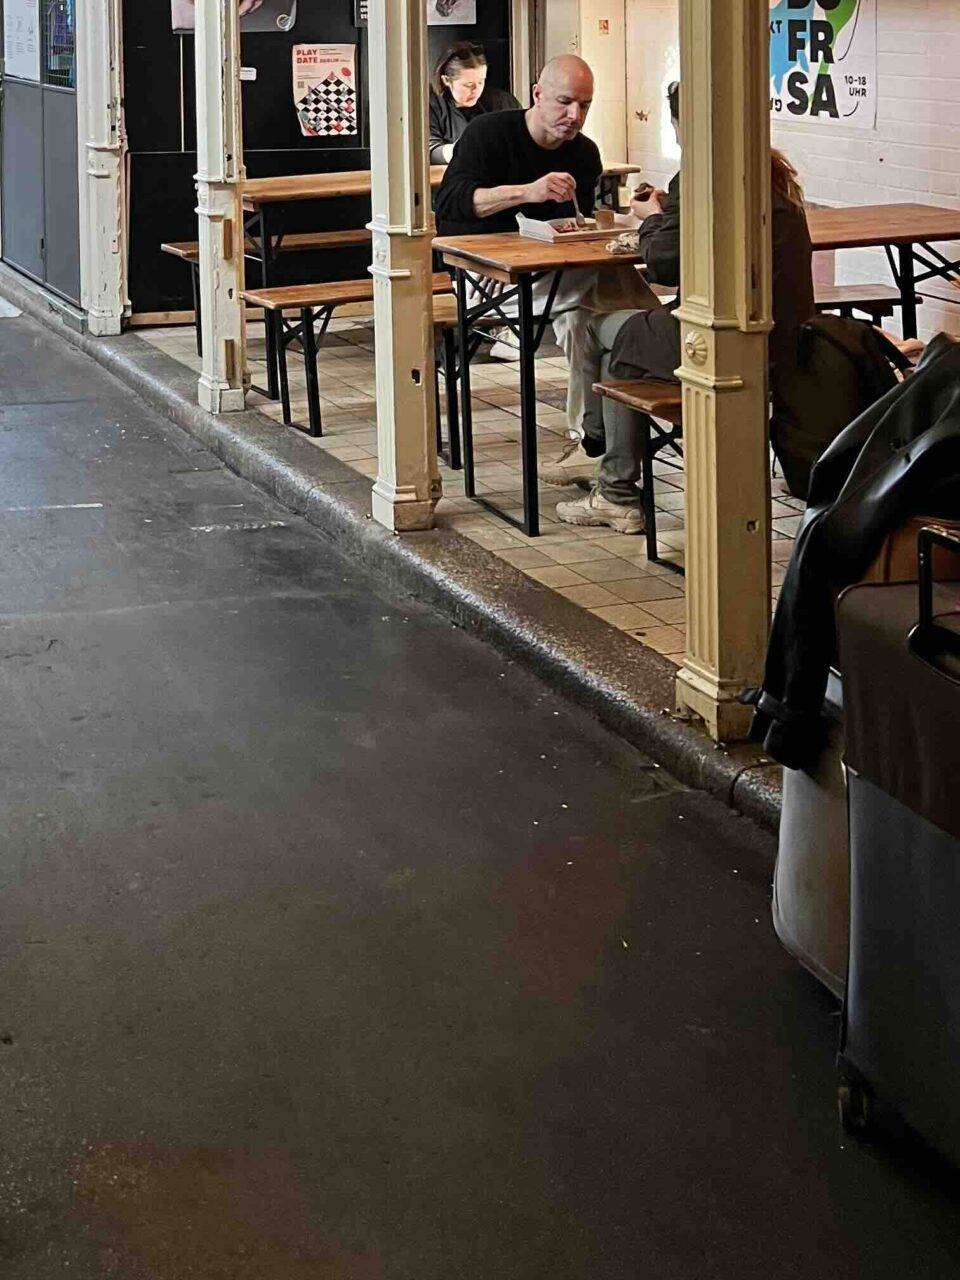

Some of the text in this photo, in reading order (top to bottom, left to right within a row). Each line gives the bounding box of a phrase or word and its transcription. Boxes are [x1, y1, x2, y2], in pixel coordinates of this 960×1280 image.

[788, 19, 835, 64] FR
[296, 56, 318, 64] DATE
[844, 75, 867, 86] 10-18
[786, 71, 840, 119] SA
[849, 87, 867, 98] UHR
